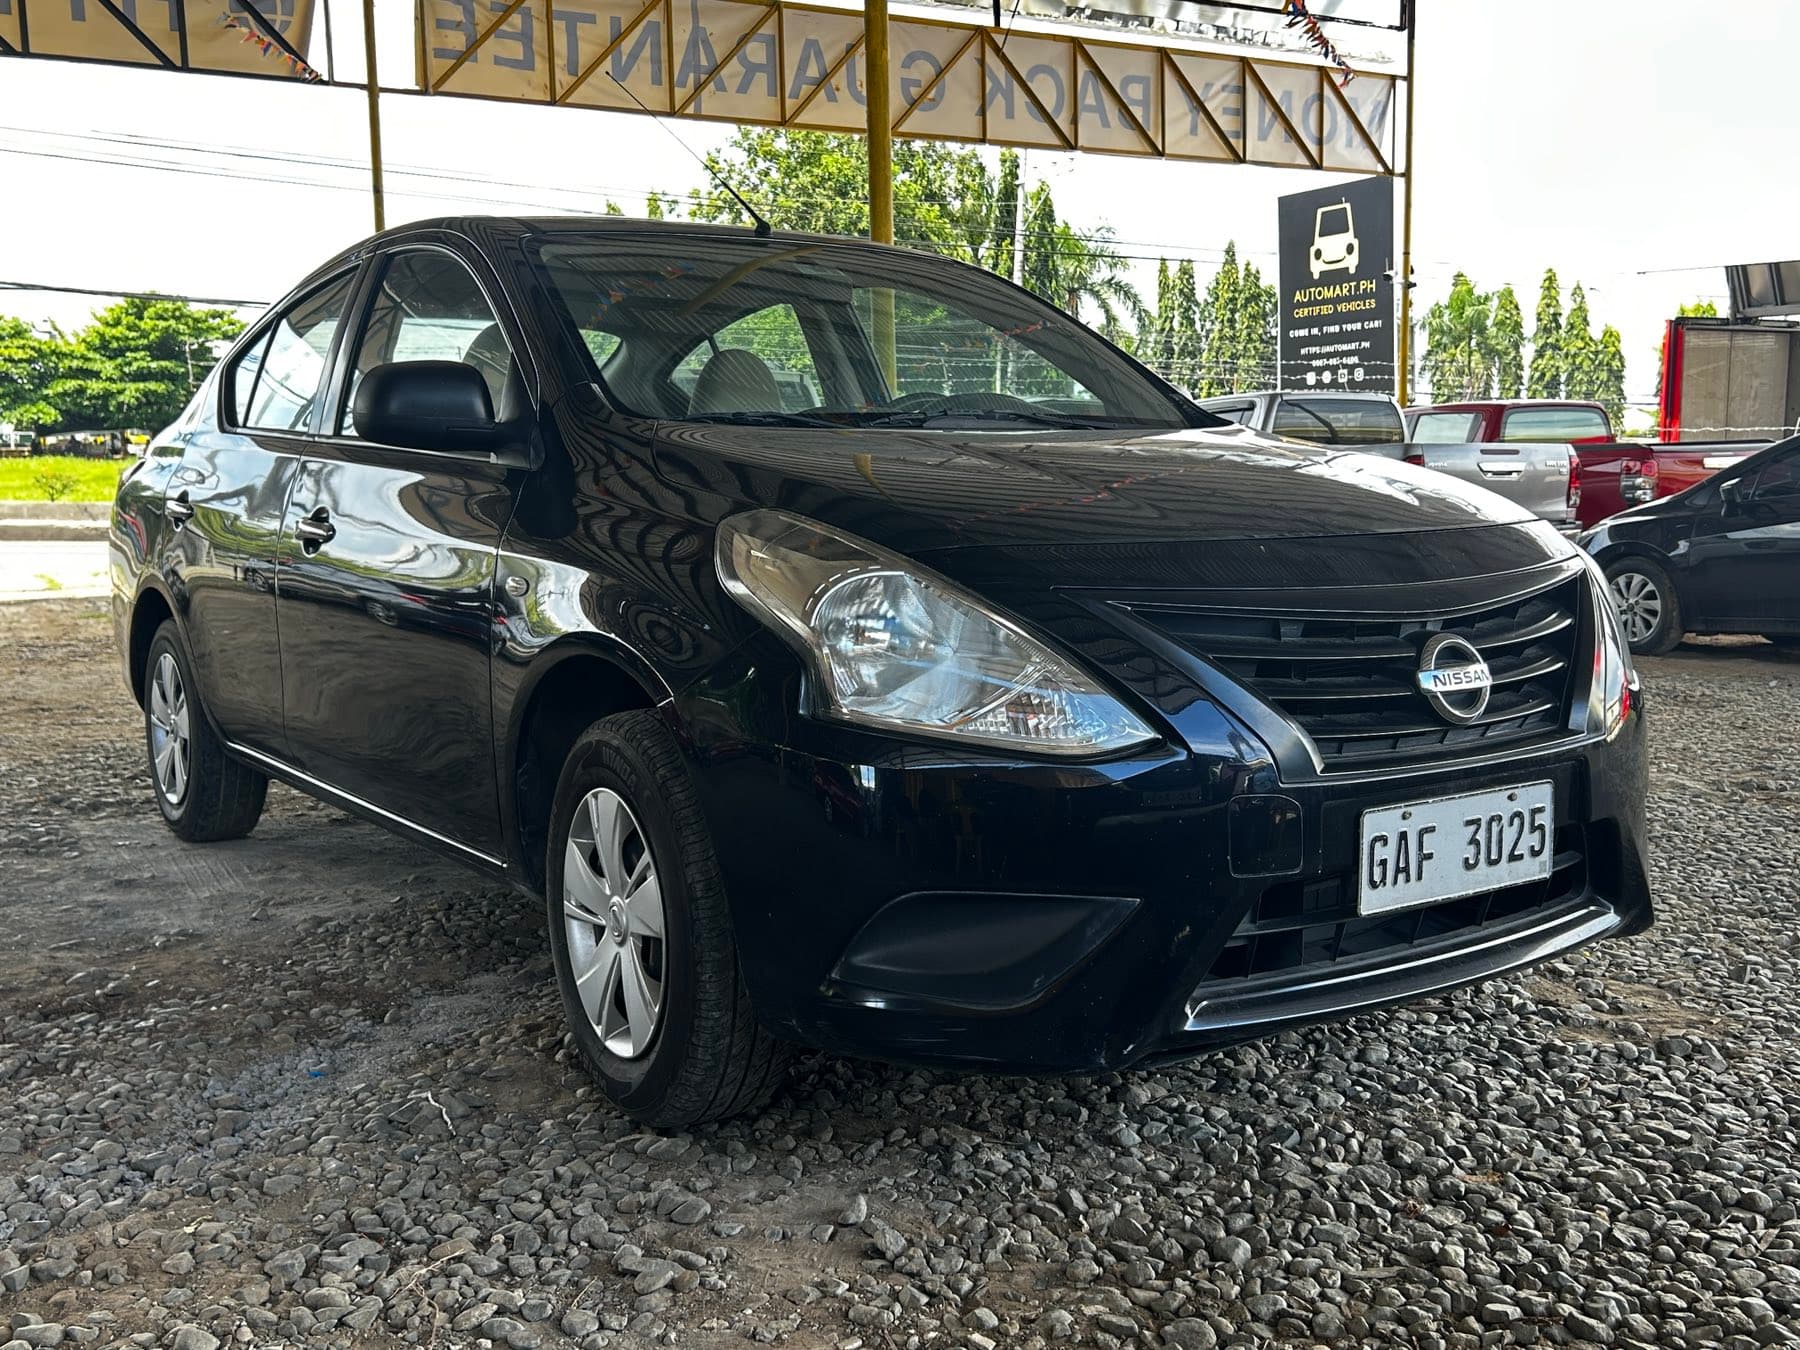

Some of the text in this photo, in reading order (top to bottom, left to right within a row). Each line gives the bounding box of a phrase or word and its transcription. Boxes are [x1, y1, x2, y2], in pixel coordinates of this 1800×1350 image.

[1294, 279, 1376, 303] AUTOMART.PH
[1293, 299, 1376, 318] CERTIFIED VEHICLES
[1289, 320, 1382, 338] COME IN, FIND YOUR CAR!
[1432, 669, 1489, 687] NISSAN
[1368, 805, 1546, 890] GAF 3025
